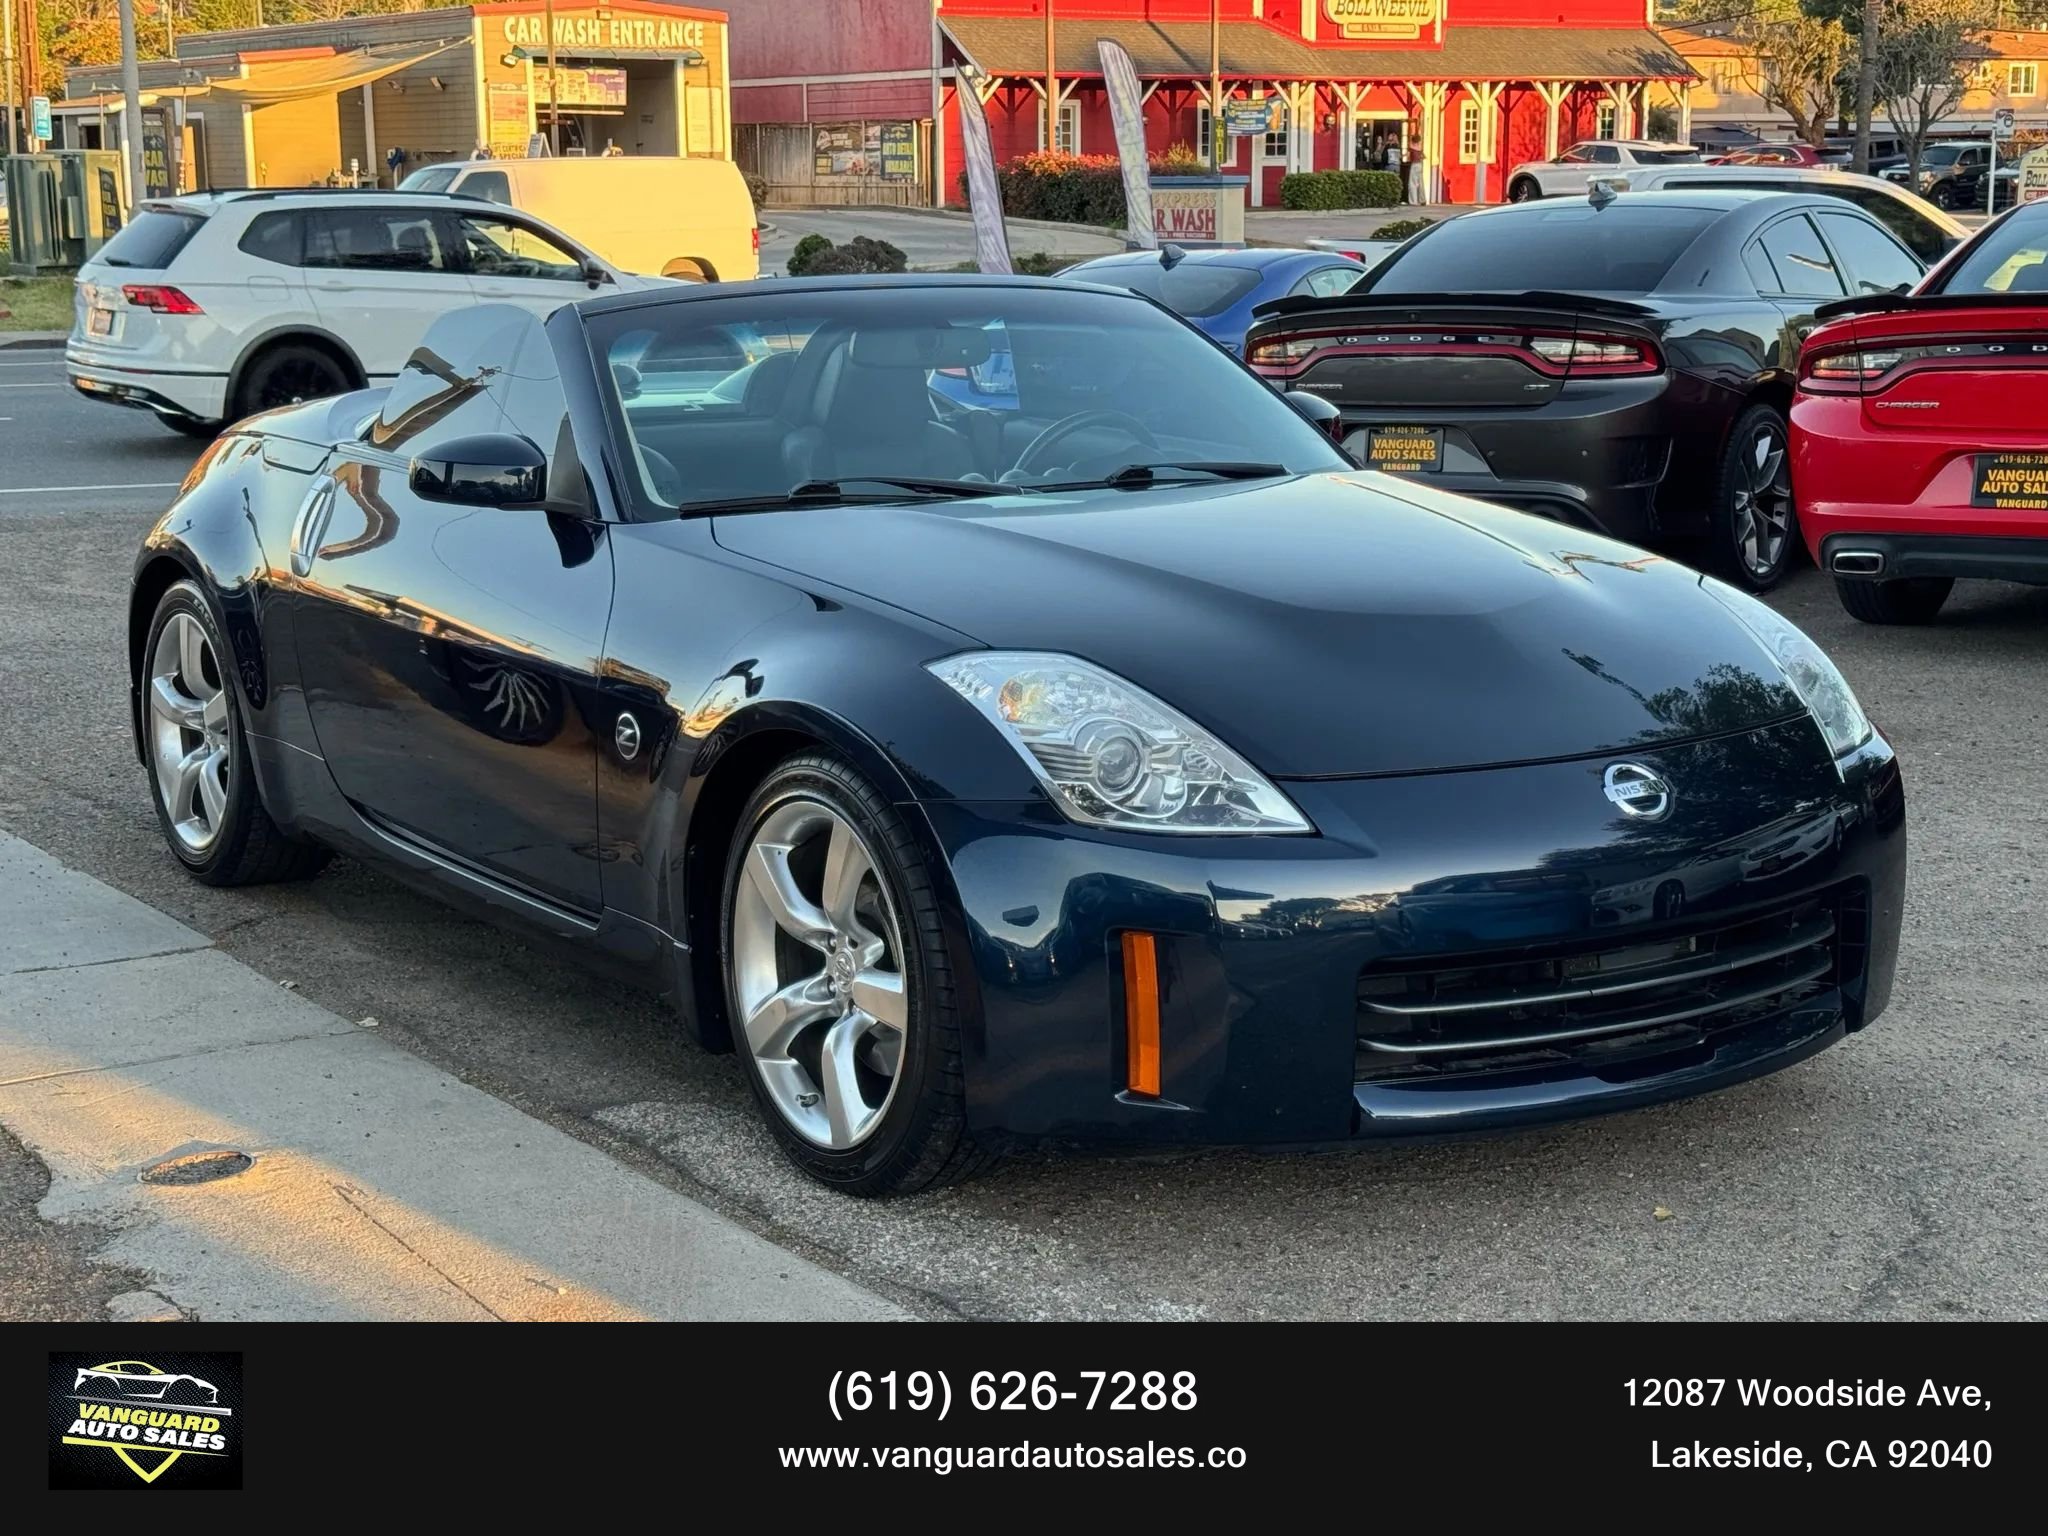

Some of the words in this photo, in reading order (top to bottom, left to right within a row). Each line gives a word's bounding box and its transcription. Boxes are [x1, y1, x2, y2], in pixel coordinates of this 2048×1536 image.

[504, 16, 543, 44] CAR
[552, 17, 601, 45] WASH
[610, 19, 704, 47] ENTRANCE
[1171, 209, 1216, 231] WASH
[1875, 401, 1941, 409] CHARGER
[1373, 438, 1436, 449] VANGUARD
[1370, 449, 1401, 460] AUTO
[1402, 450, 1437, 461] SALES
[1382, 462, 1422, 471] VANGUARD
[1981, 481, 2020, 494] AUTO
[1995, 498, 2048, 509] VANGUARD
